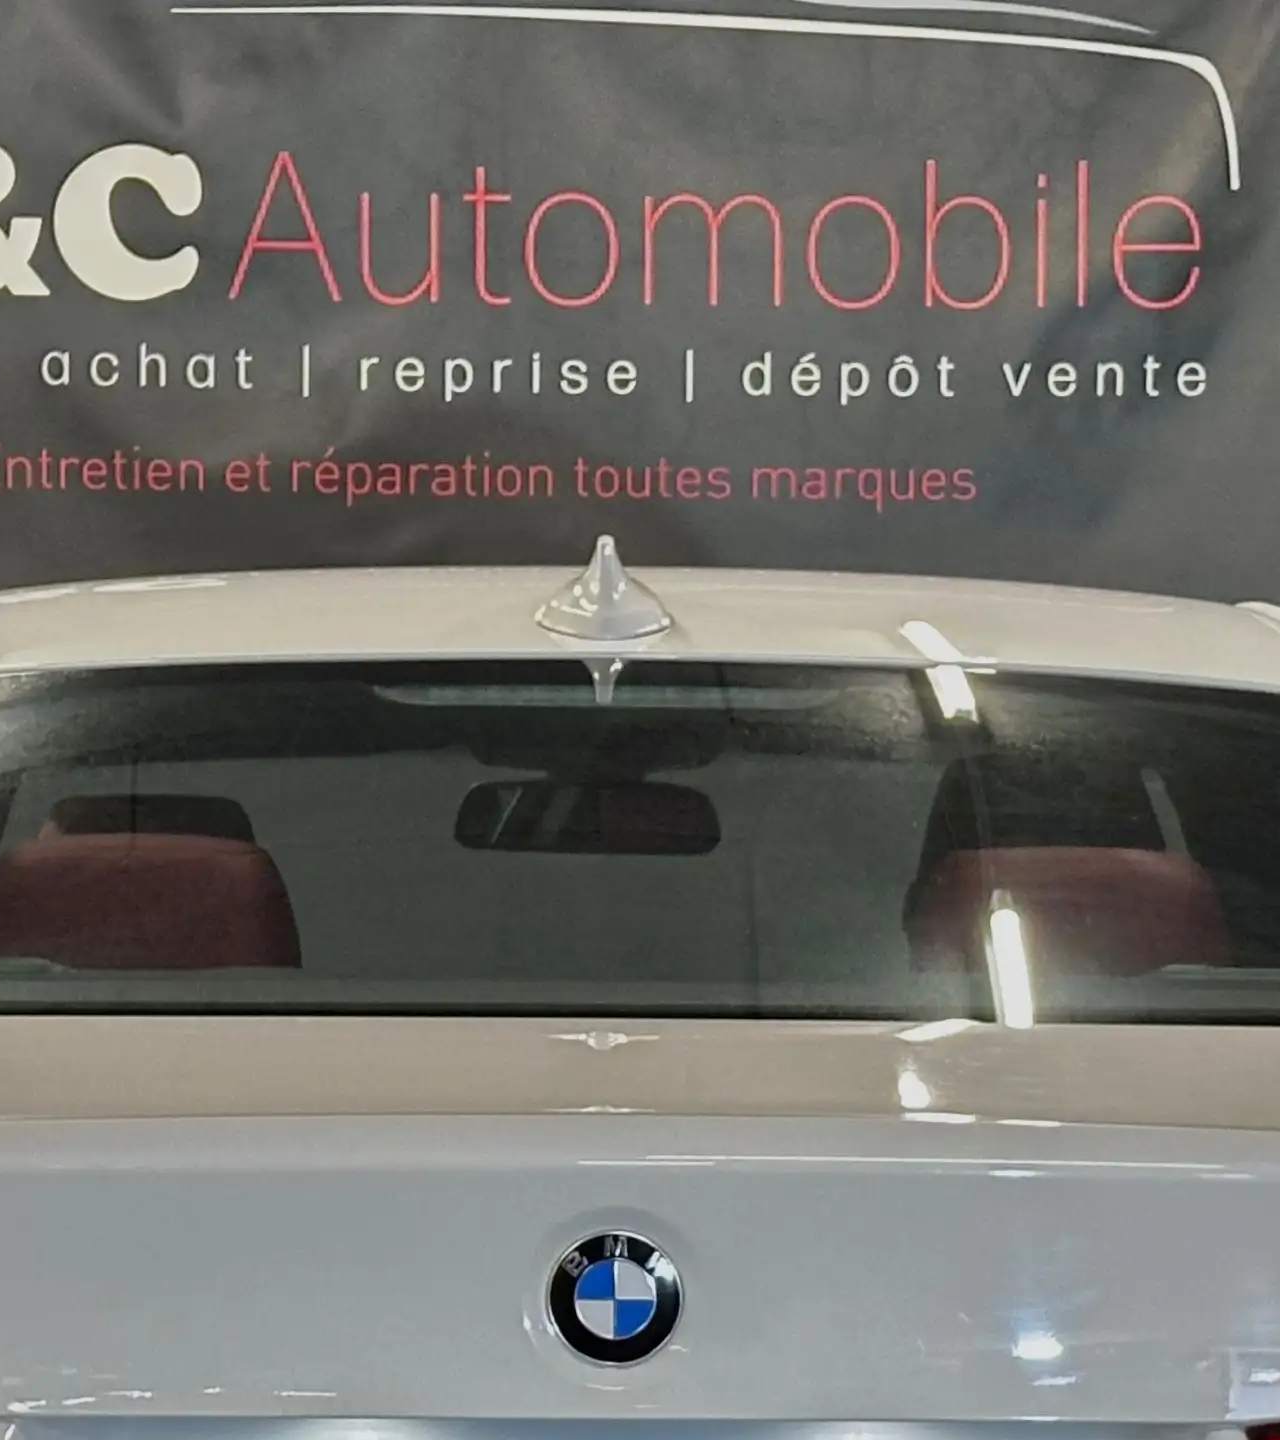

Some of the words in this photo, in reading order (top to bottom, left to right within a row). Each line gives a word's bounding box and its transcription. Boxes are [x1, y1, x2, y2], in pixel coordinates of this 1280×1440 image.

[228, 150, 1205, 311] Automobile
[40, 341, 254, 390] achat
[359, 350, 638, 403] reprise
[741, 350, 956, 407] dépôt
[1001, 355, 1208, 397] vente
[223, 456, 272, 493] et
[289, 446, 555, 507] réparation
[573, 458, 733, 501] toutes
[749, 462, 978, 514] marques
